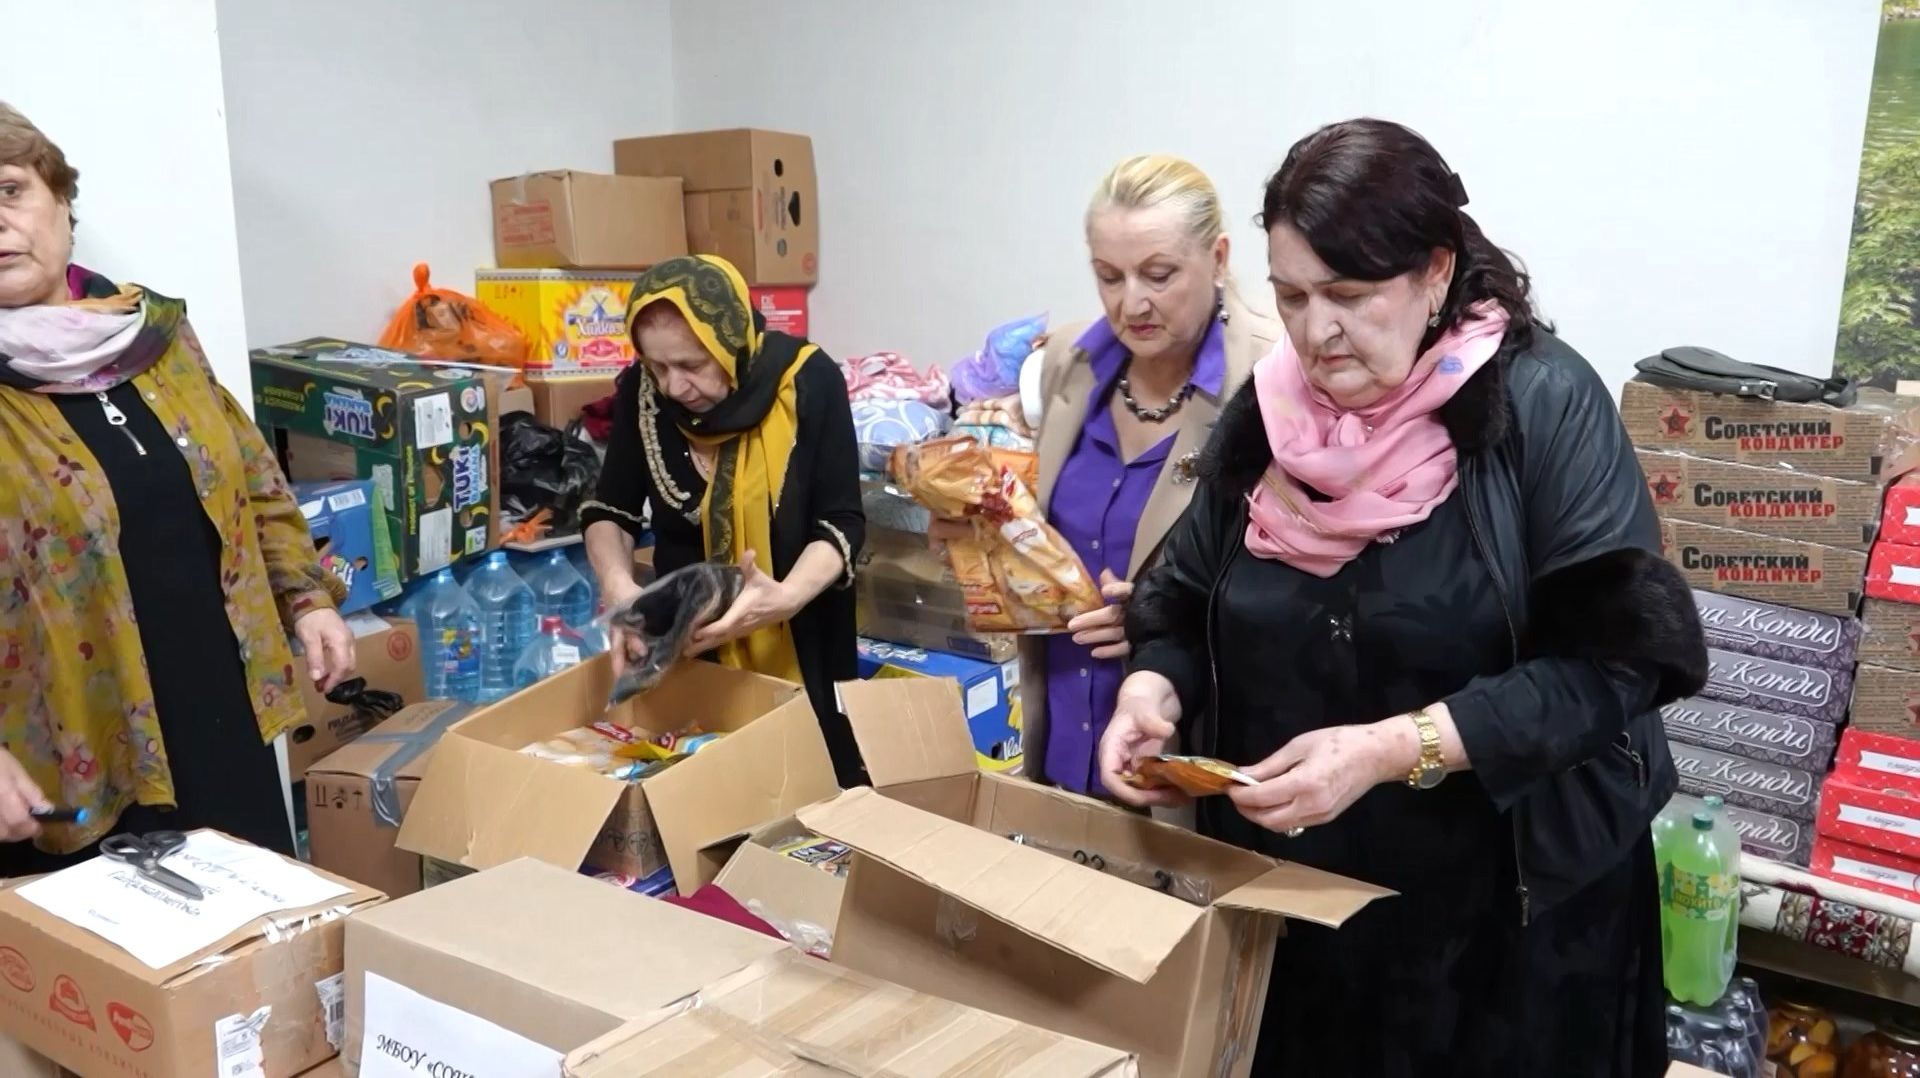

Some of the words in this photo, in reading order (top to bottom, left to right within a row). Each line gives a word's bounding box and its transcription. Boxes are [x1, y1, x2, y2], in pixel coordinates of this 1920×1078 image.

[326, 406, 375, 438] TUKI
[1740, 435, 1844, 451] КОНДИТЕР
[454, 446, 471, 511] TUKI
[1730, 502, 1836, 519] КОНДИТЕР
[1717, 567, 1822, 583] КОНДИТЕР
[376, 1034, 427, 1071] МБОУ
